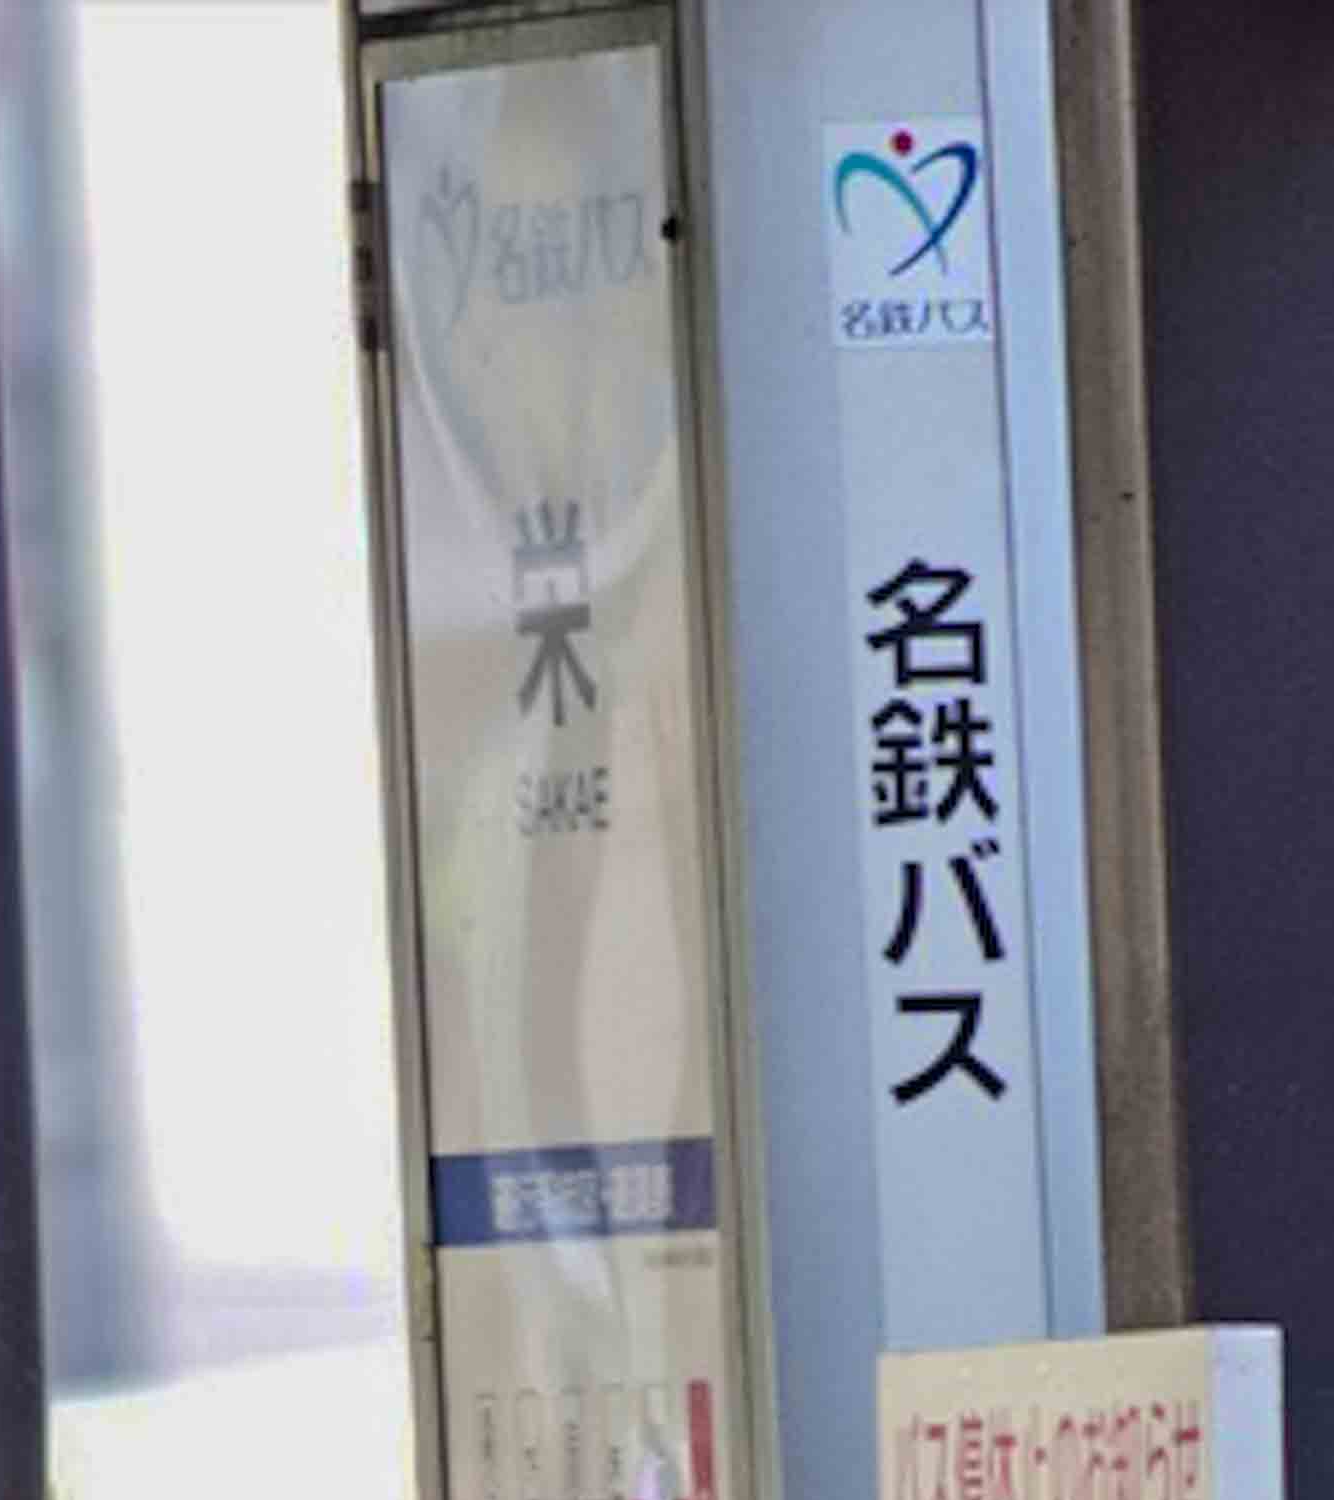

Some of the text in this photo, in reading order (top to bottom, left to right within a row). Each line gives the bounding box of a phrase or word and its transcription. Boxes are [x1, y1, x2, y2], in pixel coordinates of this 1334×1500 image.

[490, 192, 654, 306] 名鉄バス
[838, 296, 992, 340] 名鉄バス
[516, 766, 612, 836] SAKAE
[863, 556, 1010, 1106] 名鉄バス
